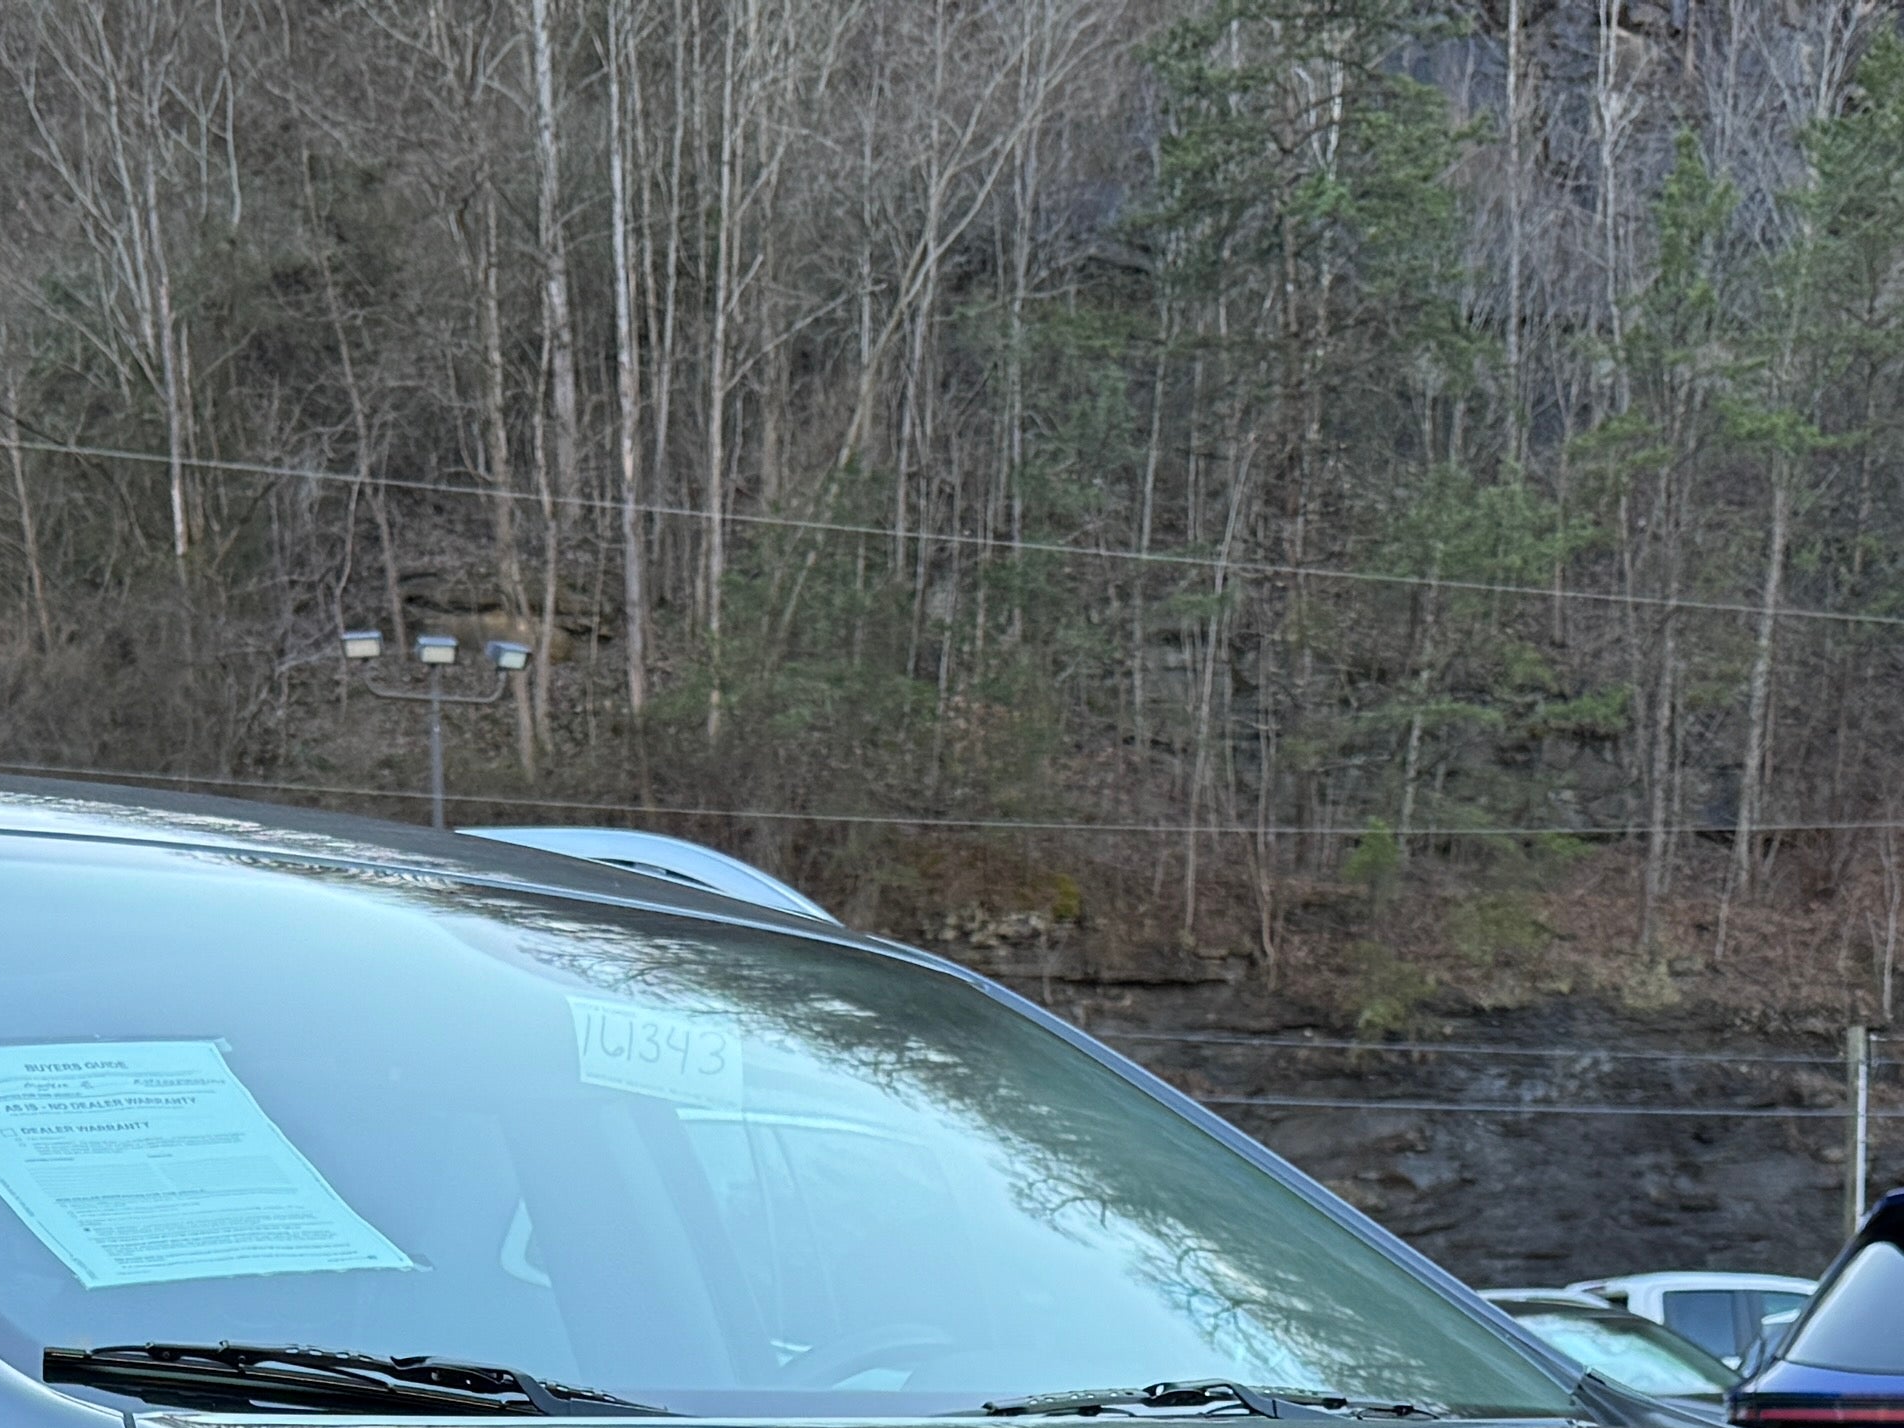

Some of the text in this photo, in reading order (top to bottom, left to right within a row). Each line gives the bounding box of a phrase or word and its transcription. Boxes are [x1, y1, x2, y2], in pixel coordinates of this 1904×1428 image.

[582, 1013, 727, 1075] 161343
[24, 1060, 129, 1073] BUYERS GUIDE
[5, 1104, 23, 1113] AS
[24, 1103, 39, 1112] IS
[48, 1102, 68, 1111] NO
[69, 1099, 124, 1110] DEALER
[124, 1096, 196, 1105] WARRANTY
[21, 1121, 149, 1135] DEALER WARRANTY
